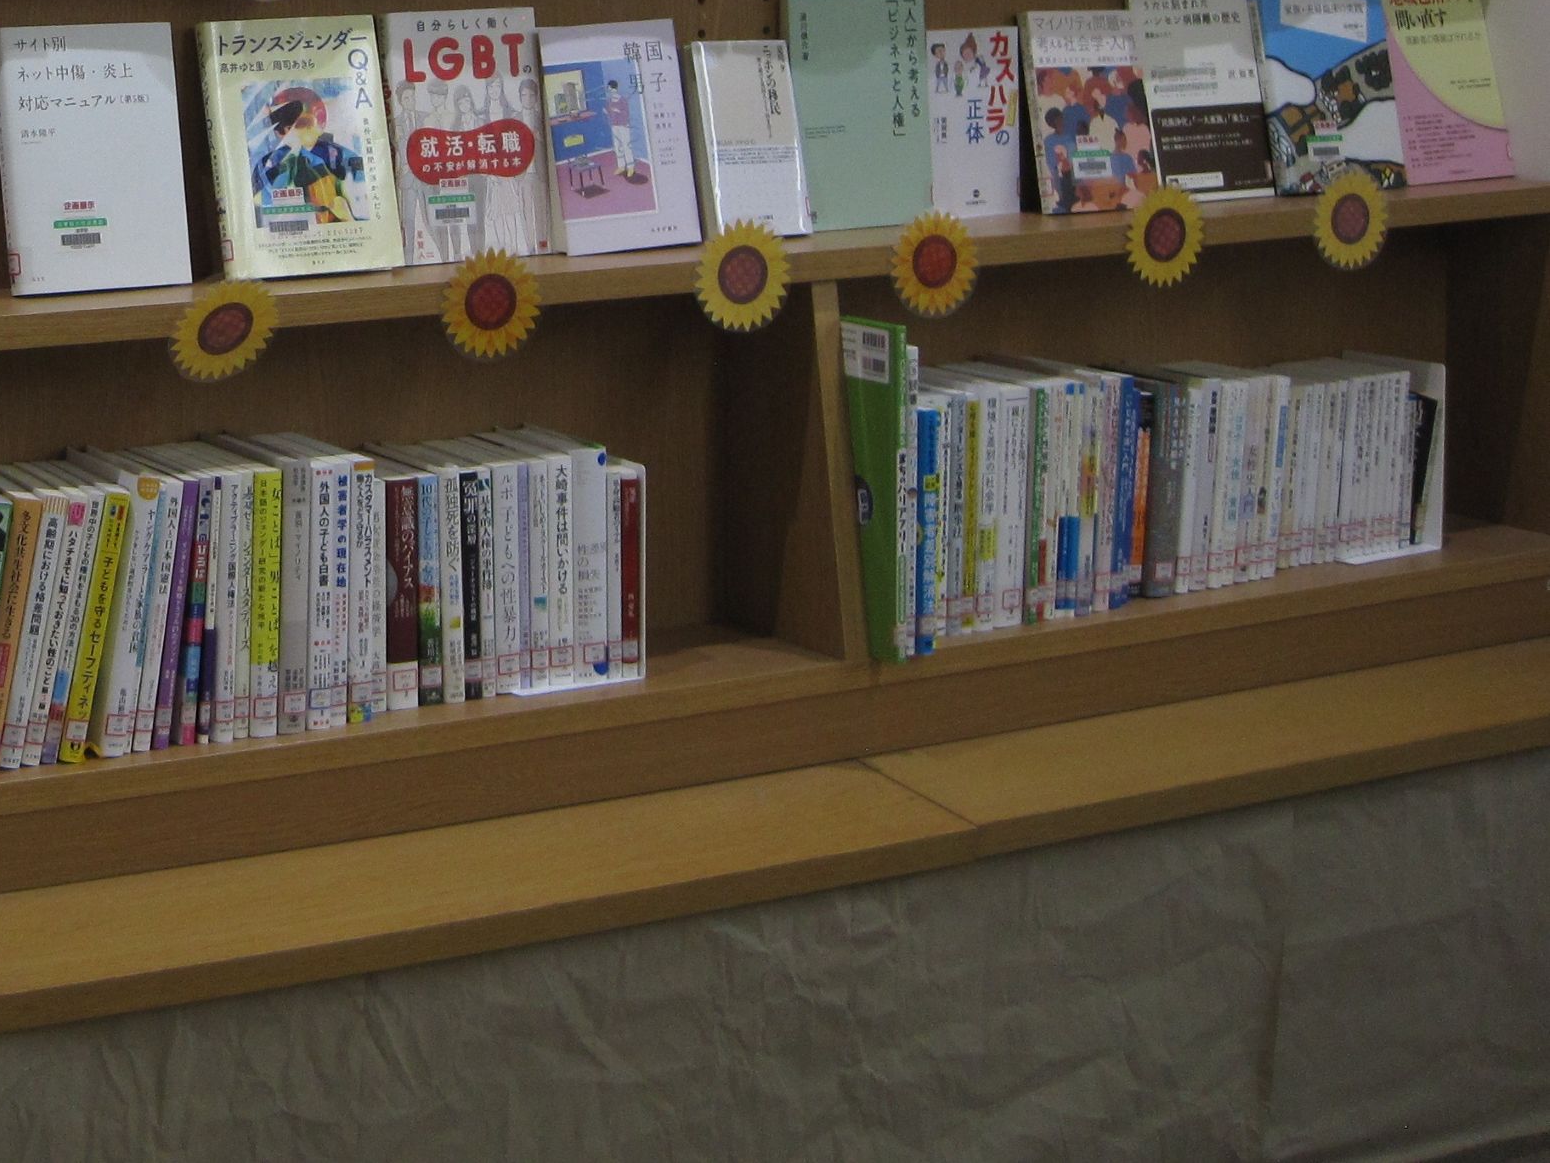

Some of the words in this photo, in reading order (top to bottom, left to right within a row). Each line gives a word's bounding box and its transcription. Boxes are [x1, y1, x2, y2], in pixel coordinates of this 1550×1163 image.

[13, 35, 68, 52] サイト別
[218, 28, 368, 57] トランスジェンダー
[416, 16, 510, 34] 自分らしく働く
[1143, 11, 1241, 28] ハンセン病隔離の歴史
[1395, 8, 1448, 31] 問い直す
[16, 62, 135, 83] ネット中傷・炎上
[403, 32, 525, 83] LGBT
[522, 63, 532, 75] の
[622, 40, 674, 65] 韓国、
[17, 92, 116, 113] 対応マニュアル
[347, 48, 373, 110] Q&A
[628, 71, 668, 96] 男子
[762, 44, 782, 115] ニッポンの移民
[985, 31, 1015, 147] カスハラの
[419, 130, 522, 159] 就活・転職
[966, 98, 985, 145] 正体
[421, 158, 522, 174] の不安が解消する本
[158, 496, 179, 596] 外国人と日本国憲法
[317, 481, 331, 587] 外国人の子ども白書
[362, 474, 374, 588] カスタマーハラスメント
[443, 478, 461, 574] 孤独死を防ぐ
[554, 463, 571, 596] 大崎事件は問いかける
[267, 475, 283, 700] 「女ことば」「男ことば」を越え
[499, 505, 517, 644] 子どもへの性暴力
[77, 554, 116, 720] 子どもを守るセーフティネッ
